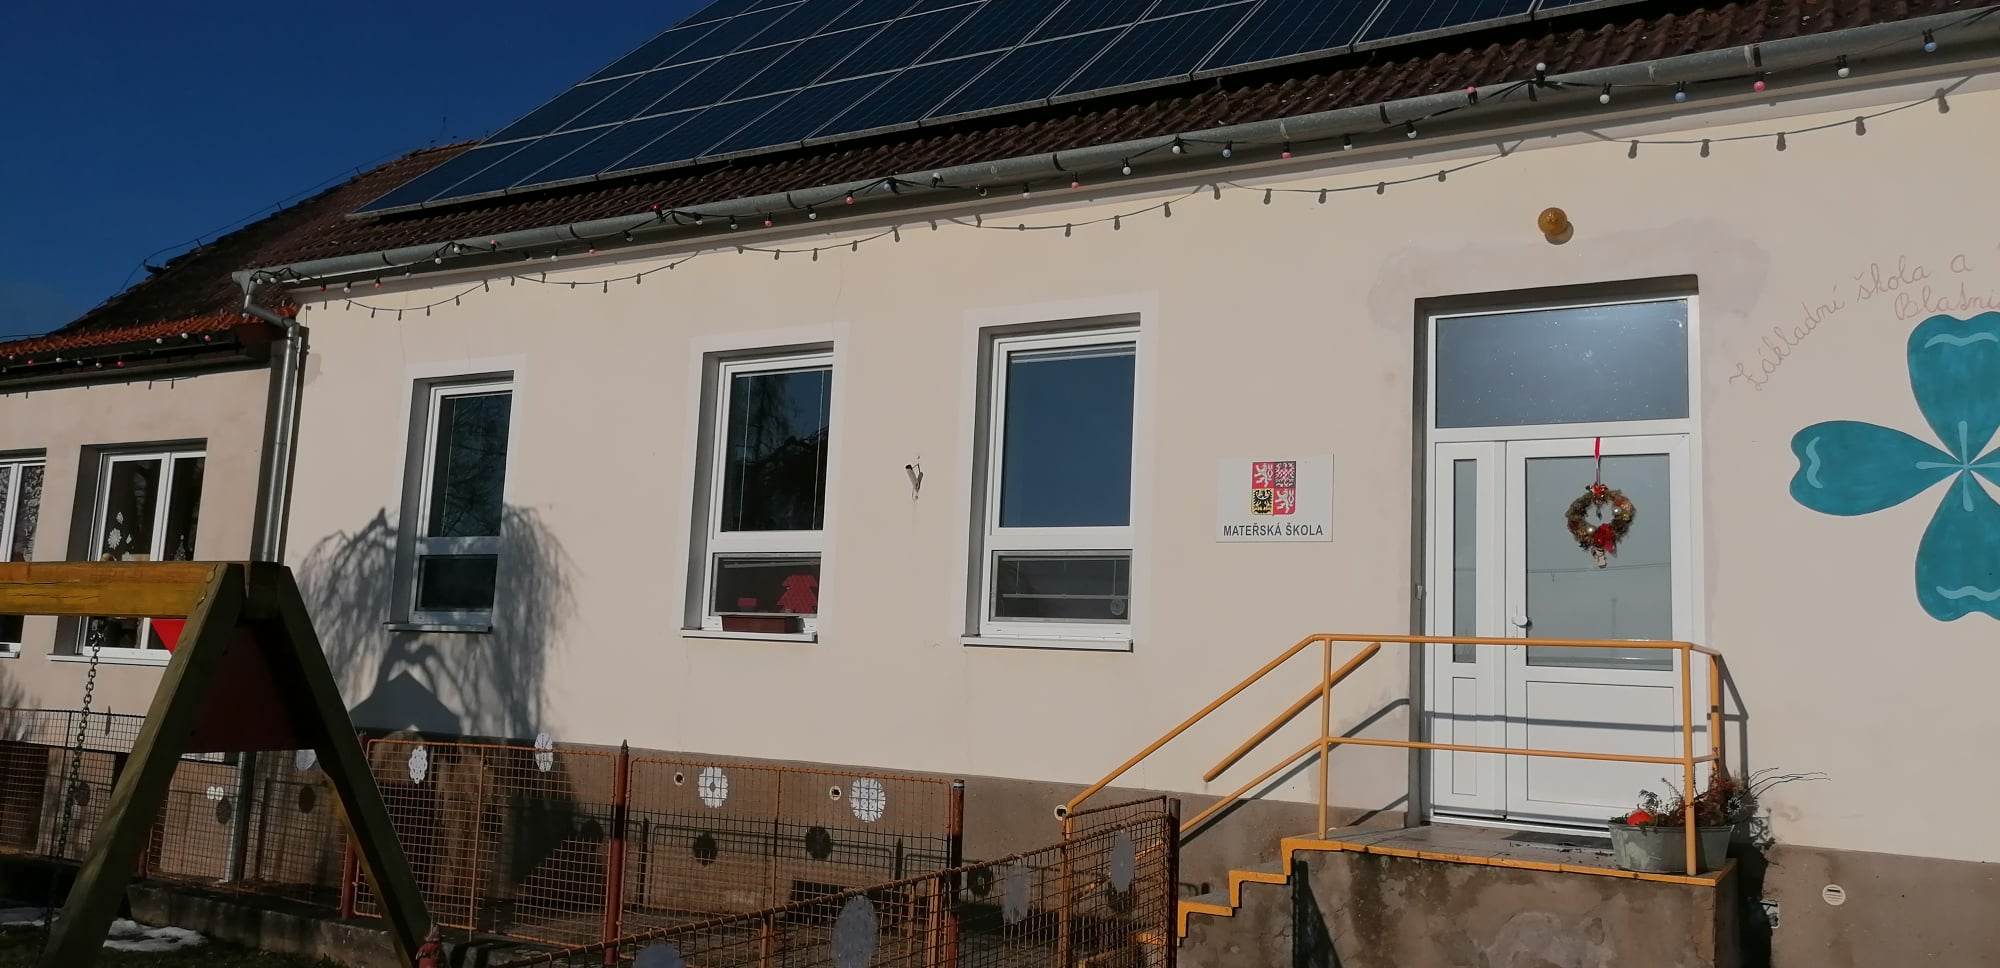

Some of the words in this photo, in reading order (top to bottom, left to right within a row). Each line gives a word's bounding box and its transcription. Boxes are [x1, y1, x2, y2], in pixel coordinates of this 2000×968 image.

[1853, 255, 1931, 302] škola
[1950, 253, 1974, 274] a
[1894, 280, 2000, 320] Blatni
[1223, 522, 1282, 536] MATEŘSKÁ
[1285, 522, 1324, 536] ŠKOLA
